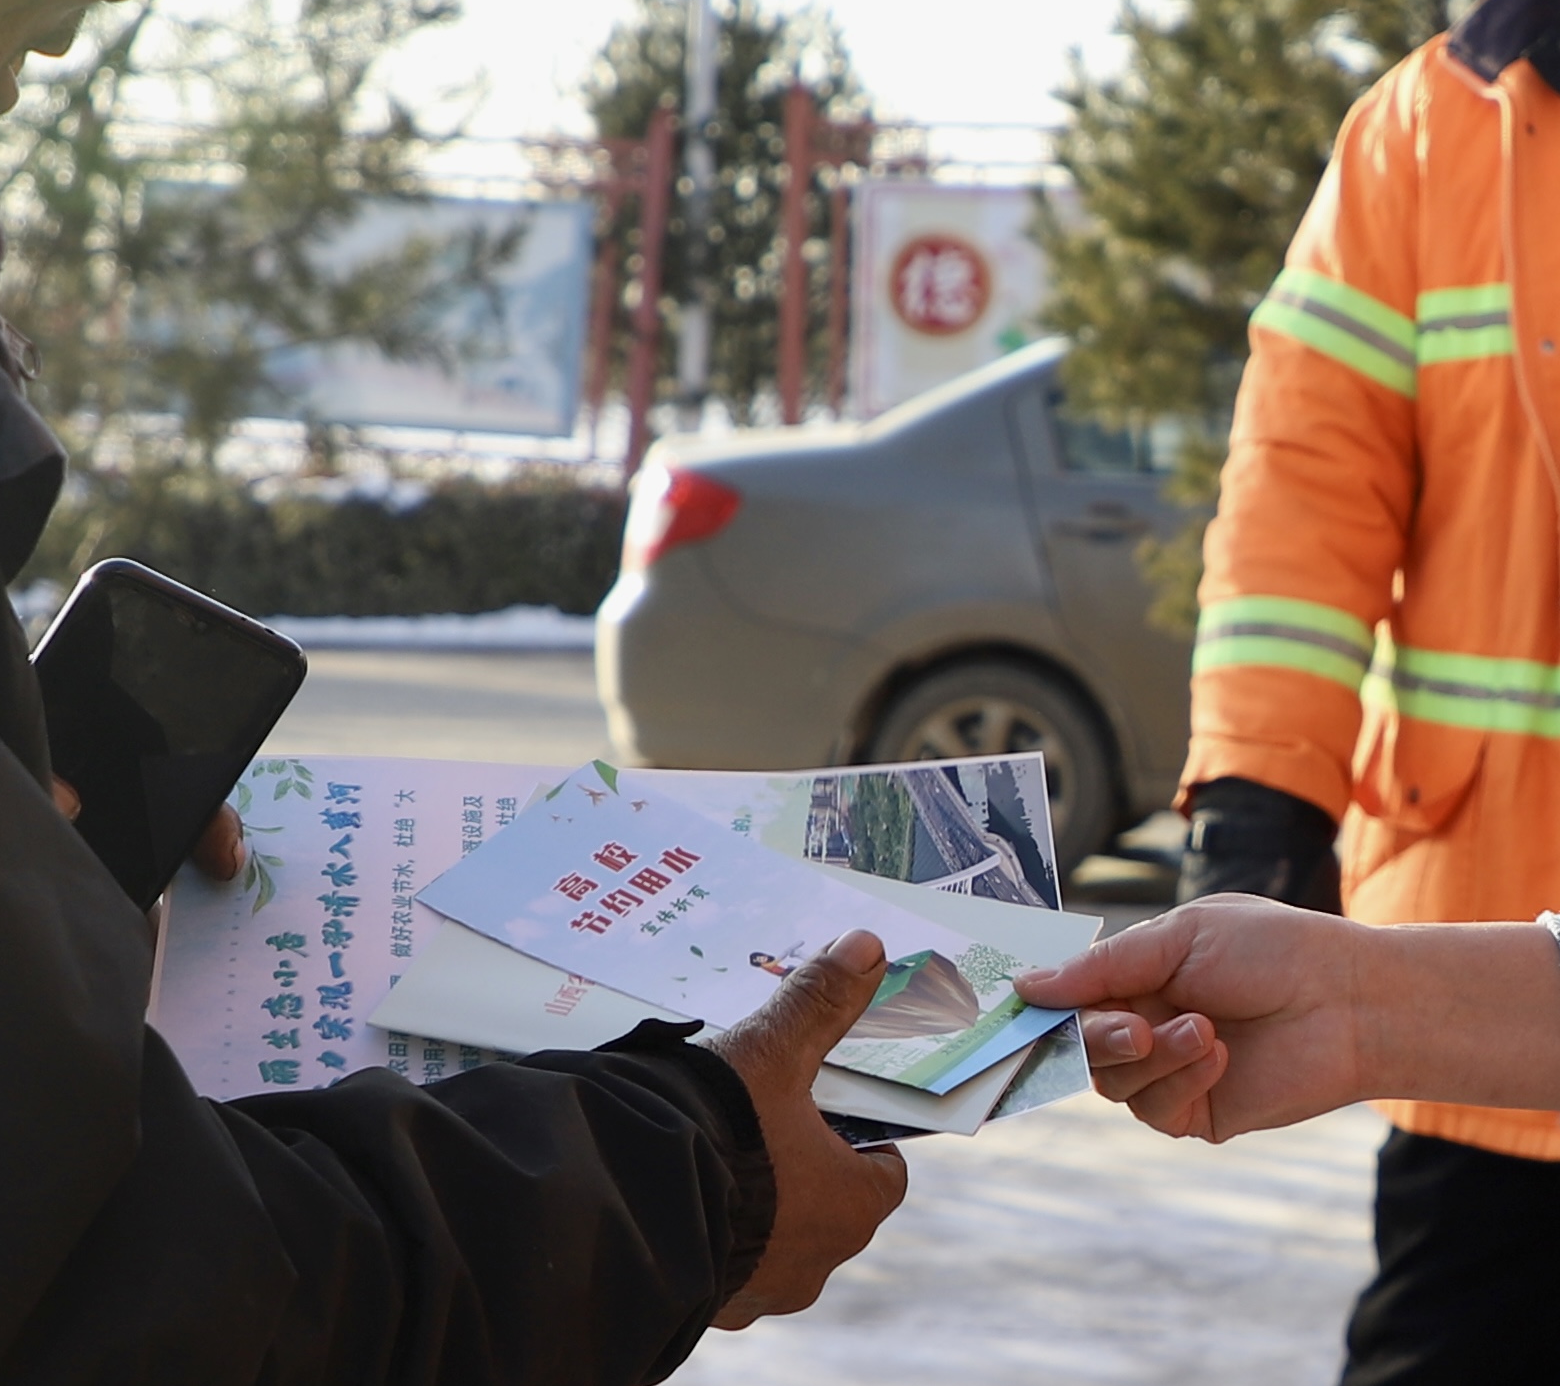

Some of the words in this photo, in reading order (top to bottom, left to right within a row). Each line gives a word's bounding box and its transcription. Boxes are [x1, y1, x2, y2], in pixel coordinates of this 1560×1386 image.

[461, 796, 484, 860] 溉设施及
[570, 846, 702, 935] 节约用水
[312, 780, 364, 1091] 力实现一泓清水入黄河
